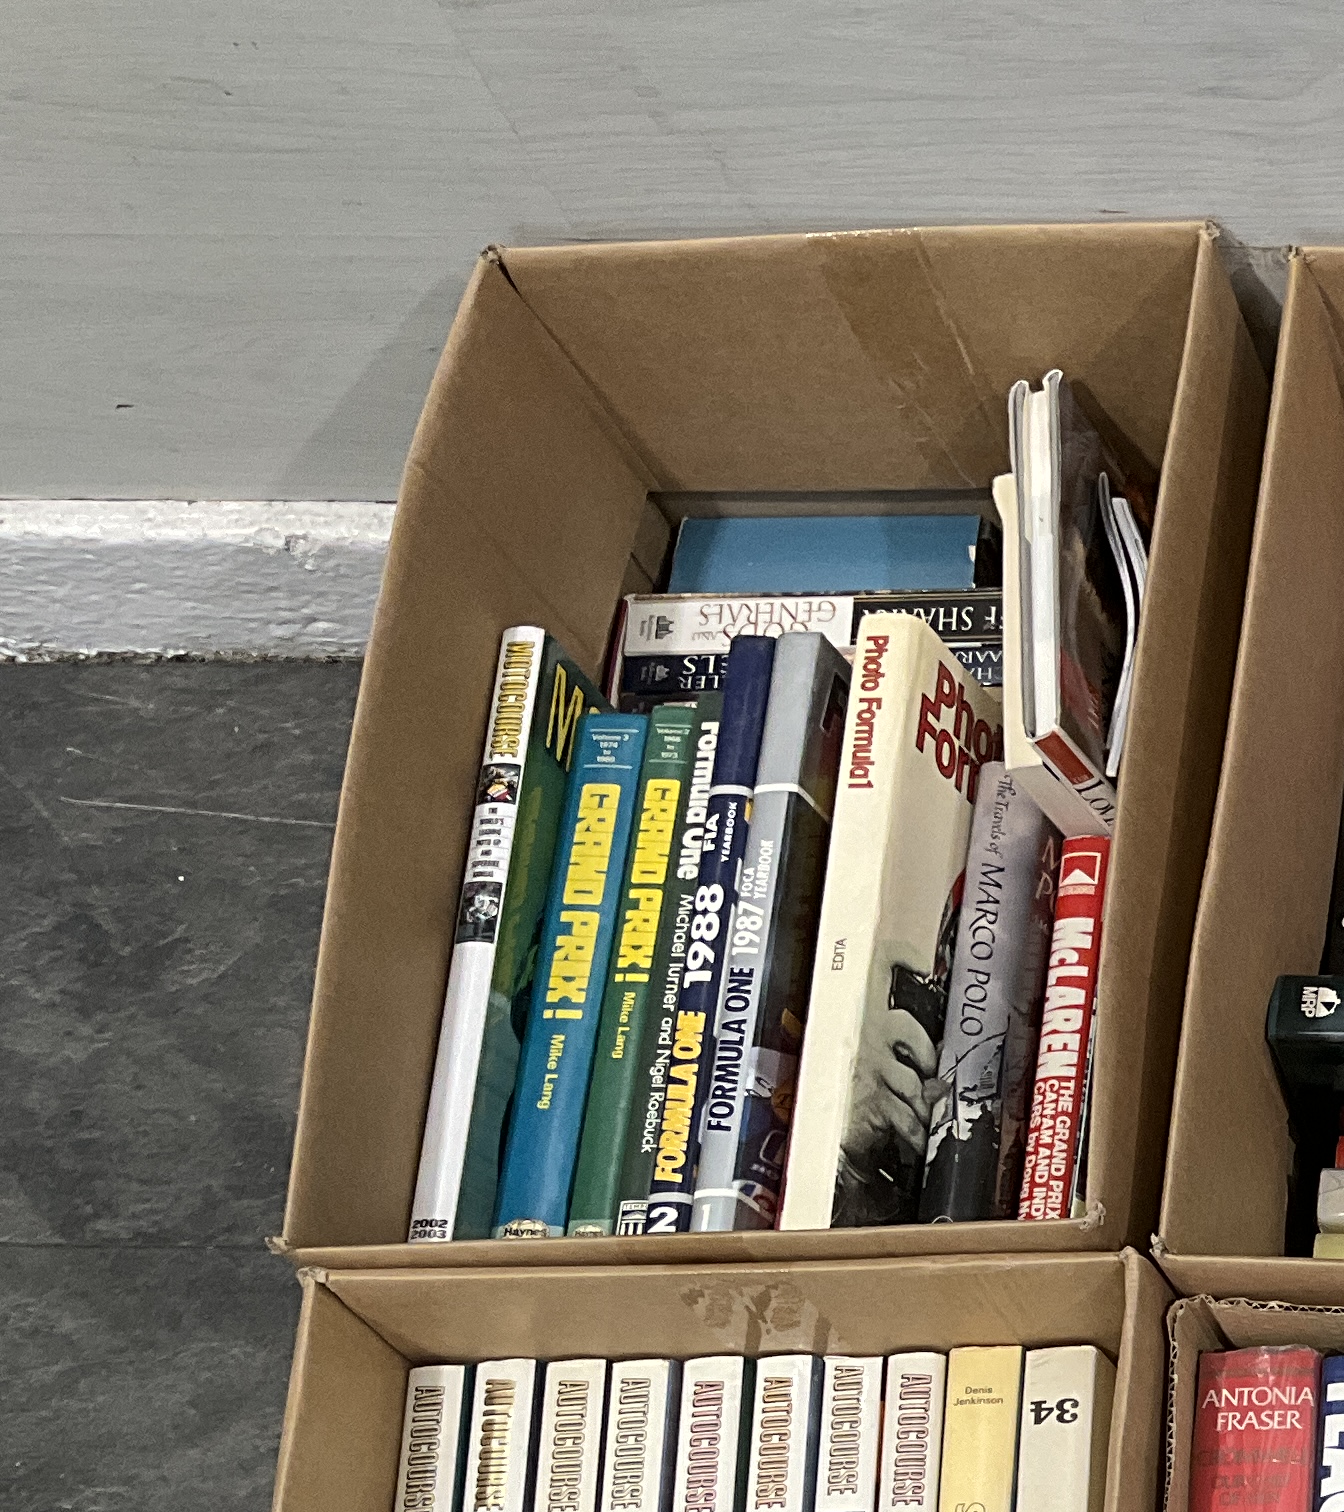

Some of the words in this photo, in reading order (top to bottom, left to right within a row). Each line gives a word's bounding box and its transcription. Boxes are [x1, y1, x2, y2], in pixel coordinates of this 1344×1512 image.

[489, 640, 535, 760] MOTOCOURSE
[703, 814, 720, 851] FIA
[721, 801, 737, 861] YEARBOOK
[741, 867, 755, 896] FOCA
[754, 840, 773, 899] YEARBOOK
[732, 900, 762, 957] 1987
[968, 863, 1006, 961] MARCO
[684, 883, 724, 989] 1988
[832, 939, 847, 970] EDITA
[725, 966, 754, 1014] ONE
[959, 968, 991, 1037] POLO
[1037, 917, 1095, 1079] McLAREN
[547, 1034, 565, 1070] Mike
[673, 1011, 706, 1059] ONE
[538, 1073, 559, 1109] Lang
[708, 1020, 747, 1132] FORMULA
[654, 1062, 698, 1183] FORMULA
[411, 1229, 447, 1240] 2003
[412, 1219, 448, 1229] 2002
[953, 1396, 1003, 1405] Jenkinson
[965, 1386, 993, 1395] Denis
[1202, 1387, 1312, 1408] ANTONIA
[1030, 1400, 1078, 1425] 34
[1216, 1409, 1302, 1431] FRASER
